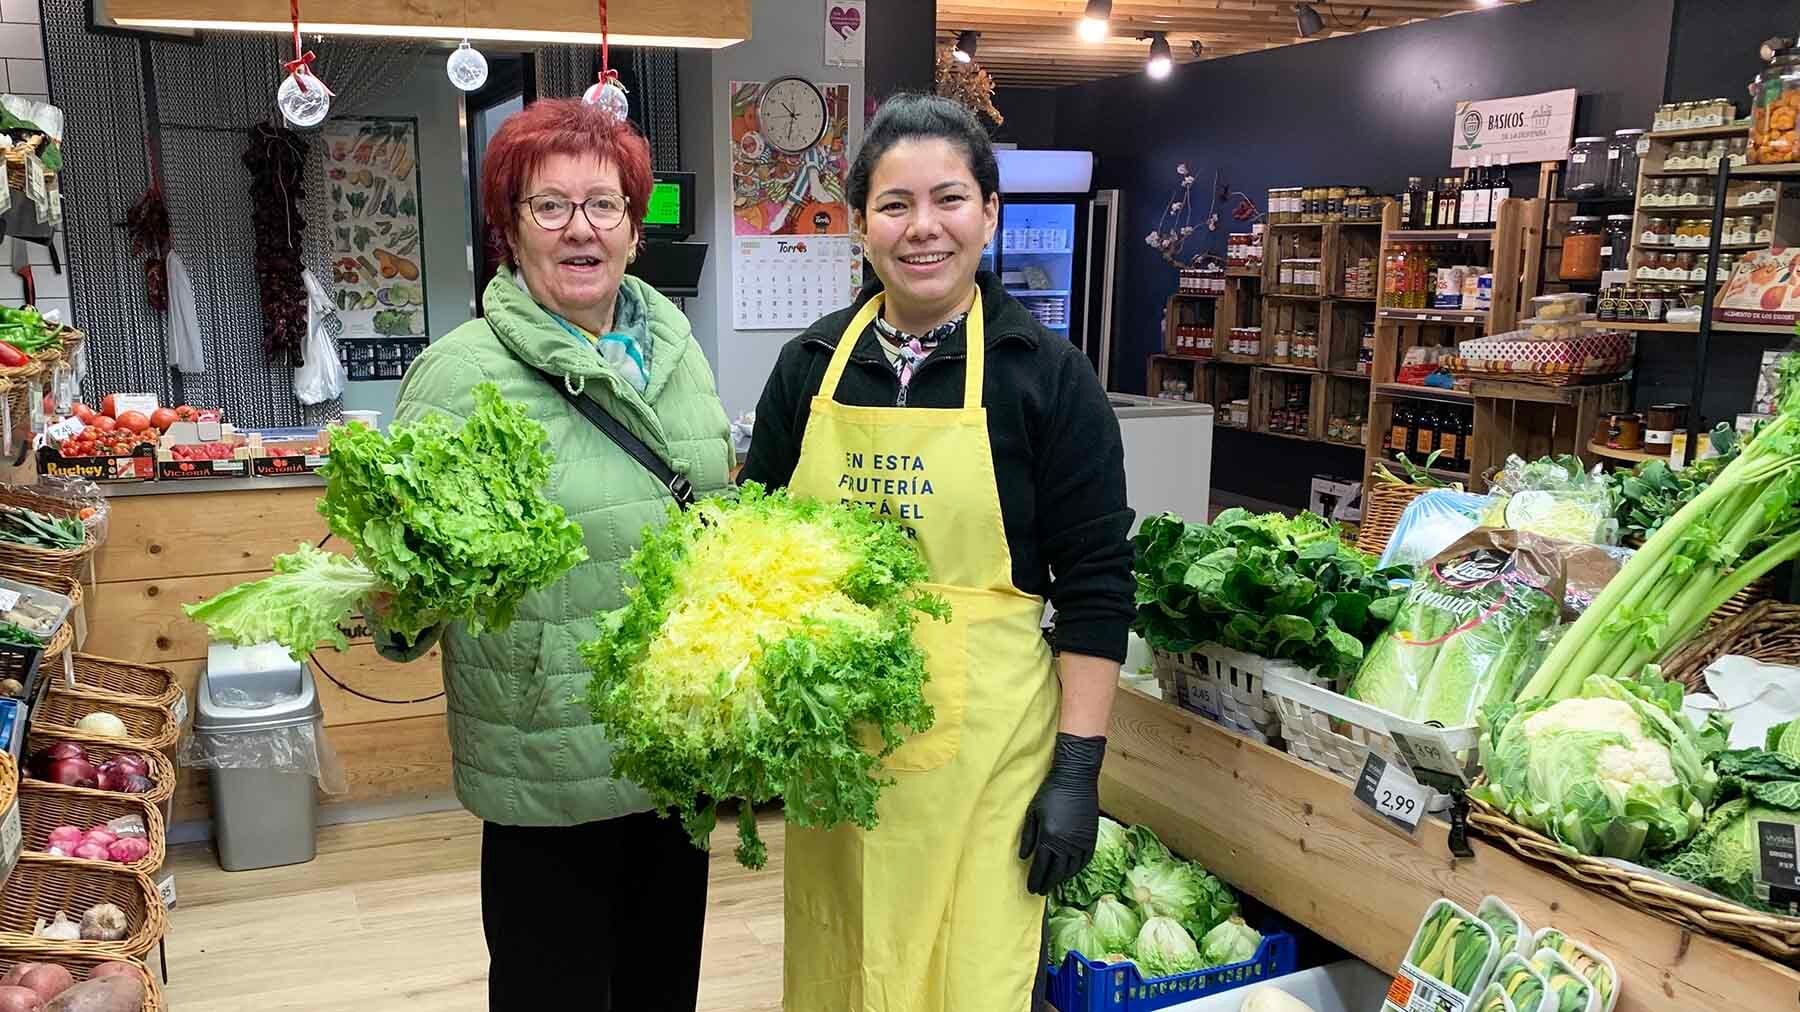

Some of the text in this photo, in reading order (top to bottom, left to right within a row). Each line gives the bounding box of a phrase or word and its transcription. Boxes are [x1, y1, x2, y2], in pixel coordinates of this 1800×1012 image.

[257, 463, 304, 474] VICTORIA
[873, 454, 925, 471] ESTA
[163, 468, 211, 477] VICTORIA
[838, 474, 934, 495] FRUTERÍA
[900, 504, 924, 520] EL
[1380, 790, 1415, 815] 2,99
